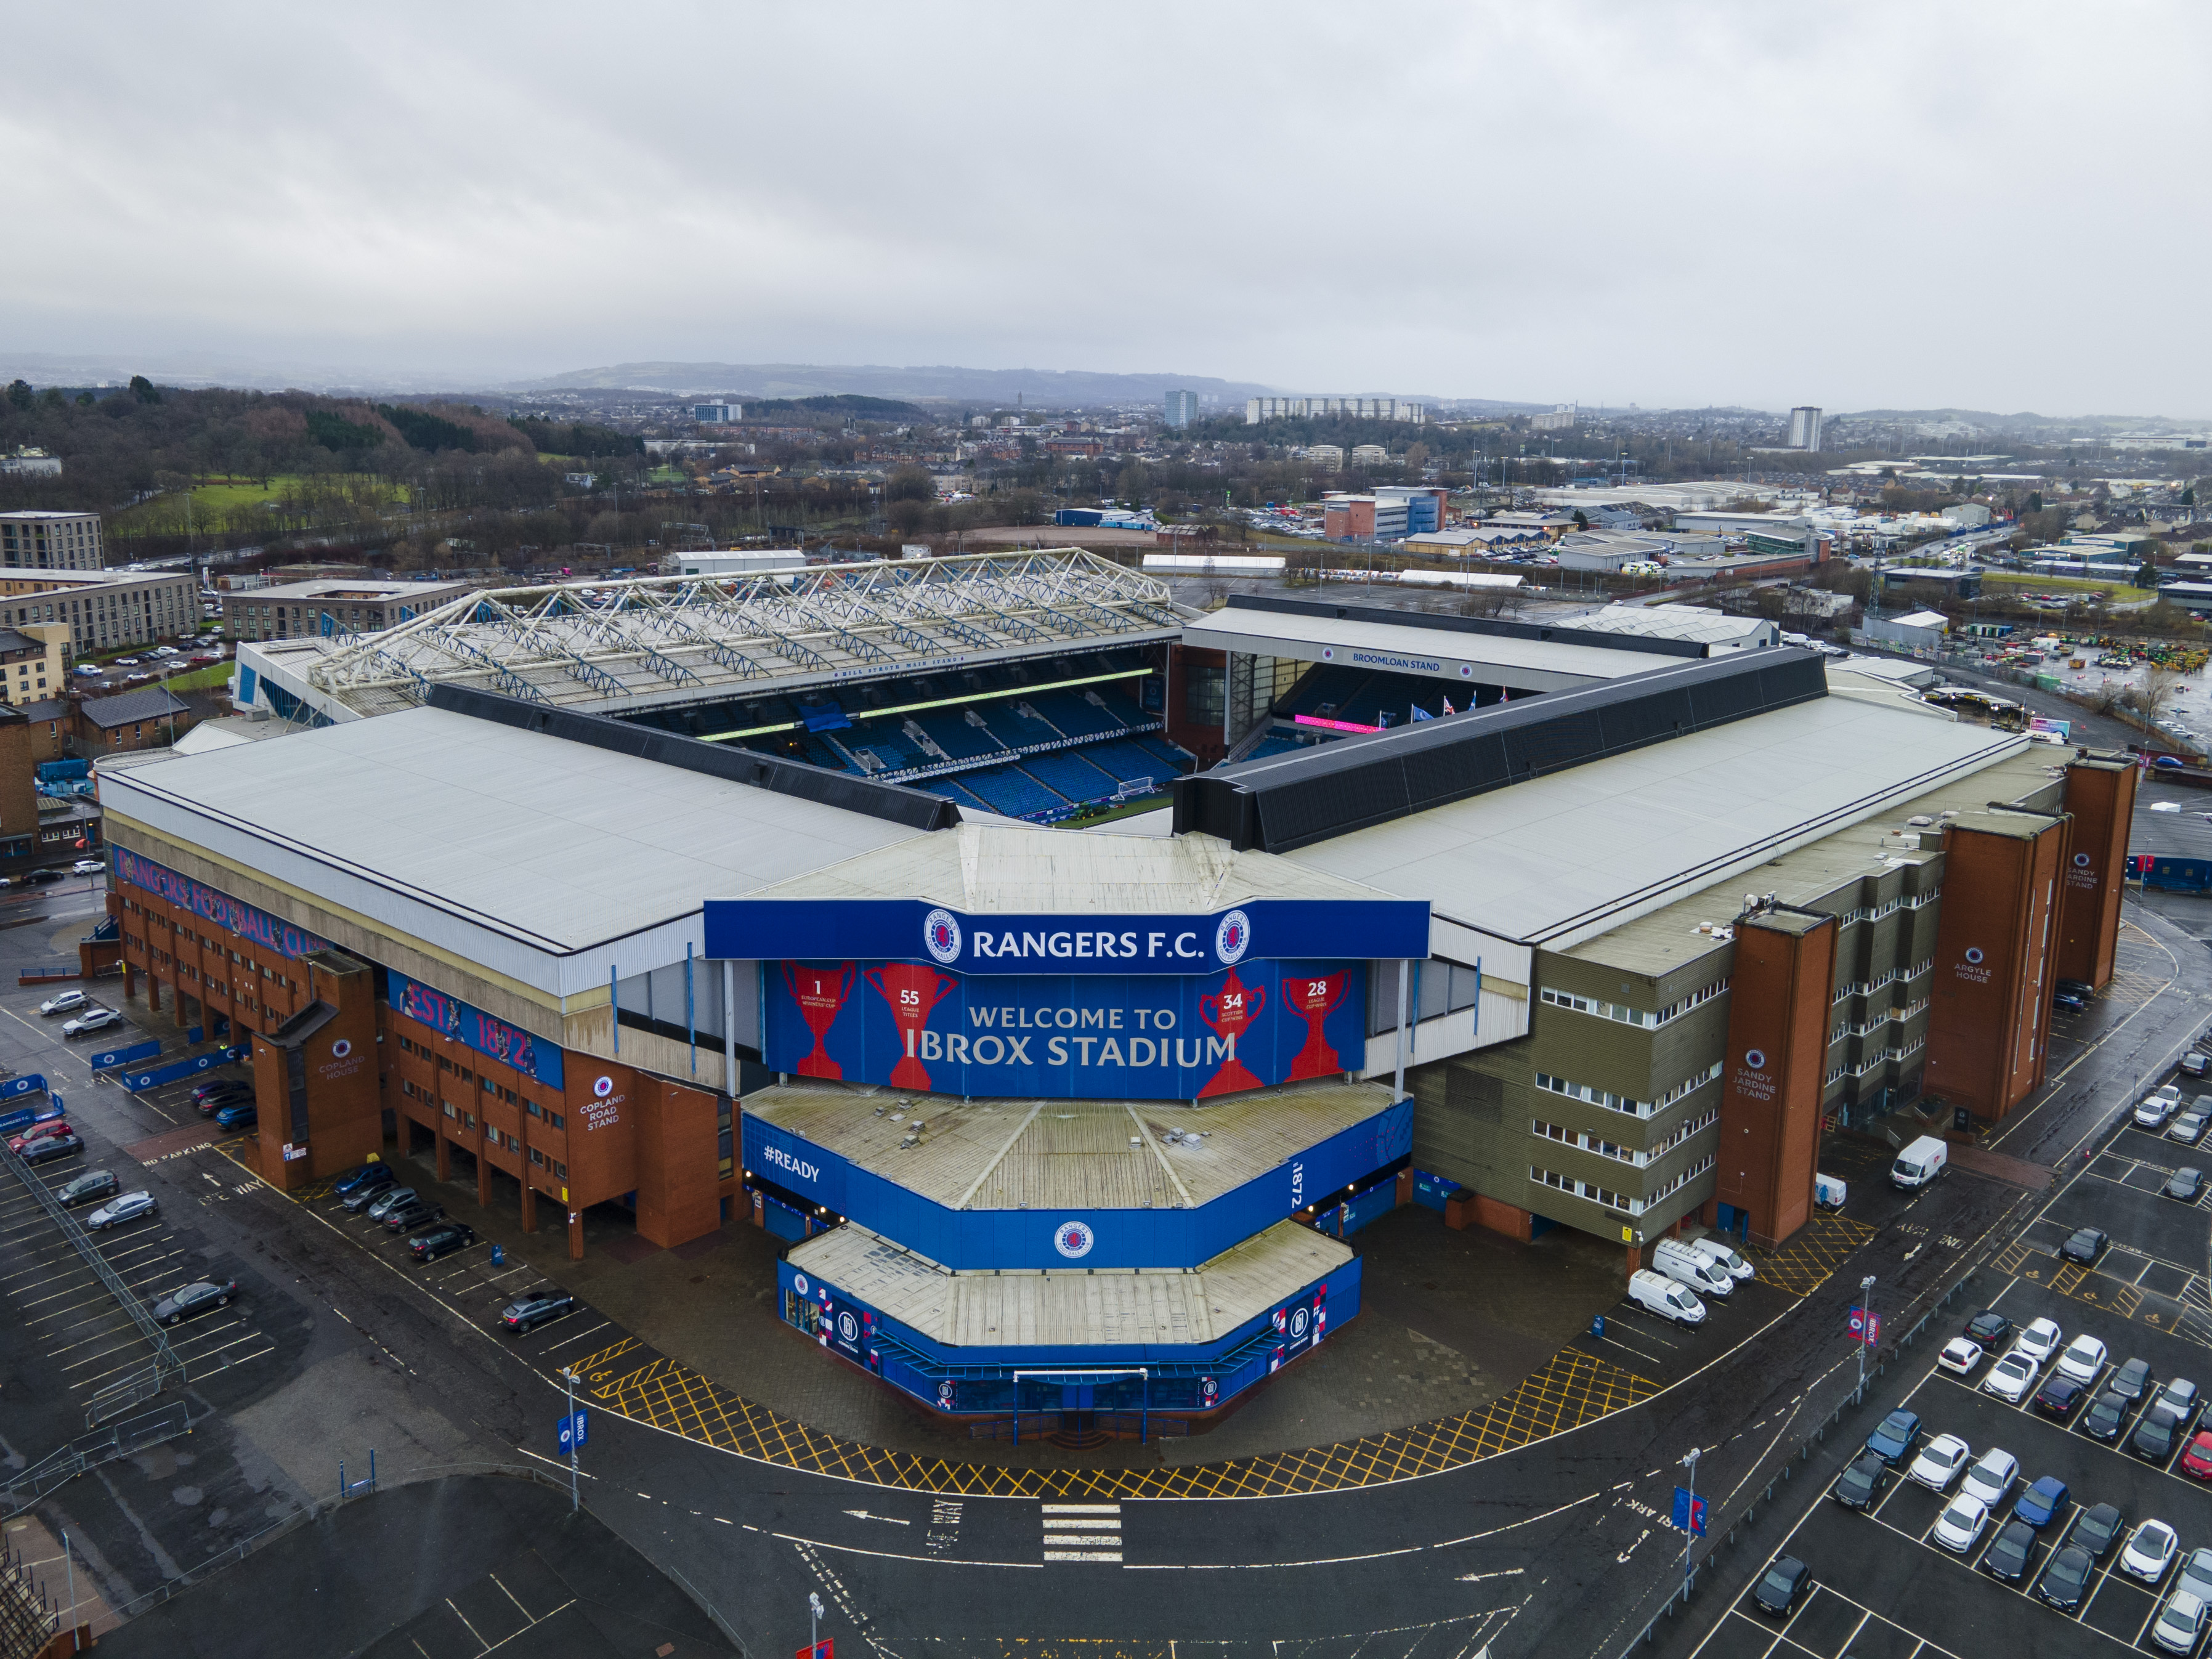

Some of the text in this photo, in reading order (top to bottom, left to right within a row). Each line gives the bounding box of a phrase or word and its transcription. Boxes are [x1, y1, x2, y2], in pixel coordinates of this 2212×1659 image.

[868, 665, 899, 673] STRUTH
[1353, 653, 1440, 671] BROOMLOAN STAND
[2067, 867, 2095, 876] SANDY
[2067, 874, 2097, 883] ARDINE
[2067, 880, 2093, 888] STAND
[118, 850, 187, 903] RANGERS
[193, 883, 277, 947] FOOTBALL
[929, 912, 957, 931] RANGERS
[1220, 914, 1246, 931] RANGERS
[973, 932, 1205, 958] RANGERS F.C.
[1954, 963, 1991, 976] ARGYLE
[1956, 971, 1988, 983] HOUSE
[814, 980, 820, 994] 1
[1308, 981, 1327, 996] 28
[900, 989, 920, 1005] 55
[1223, 993, 1242, 1009] 34
[969, 1007, 1176, 1030] WELCOME TO
[476, 1014, 525, 1067] 1872
[906, 1029, 1235, 1068] IBROX STADIUM
[319, 1055, 365, 1073] COPLAND
[326, 1066, 359, 1080] HOUSE
[1737, 1068, 1772, 1082] SANDY
[1733, 1076, 1776, 1093] JARDINE
[1736, 1085, 1770, 1101] STAND
[580, 1095, 625, 1115] COPLAND
[589, 1106, 617, 1121] ROAD
[588, 1115, 619, 1131] STAND
[161, 1142, 213, 1161] PARKING
[764, 1145, 819, 1183] #READY
[1292, 1164, 1303, 1209] 1872
[1059, 1223, 1089, 1234] RANGERS
